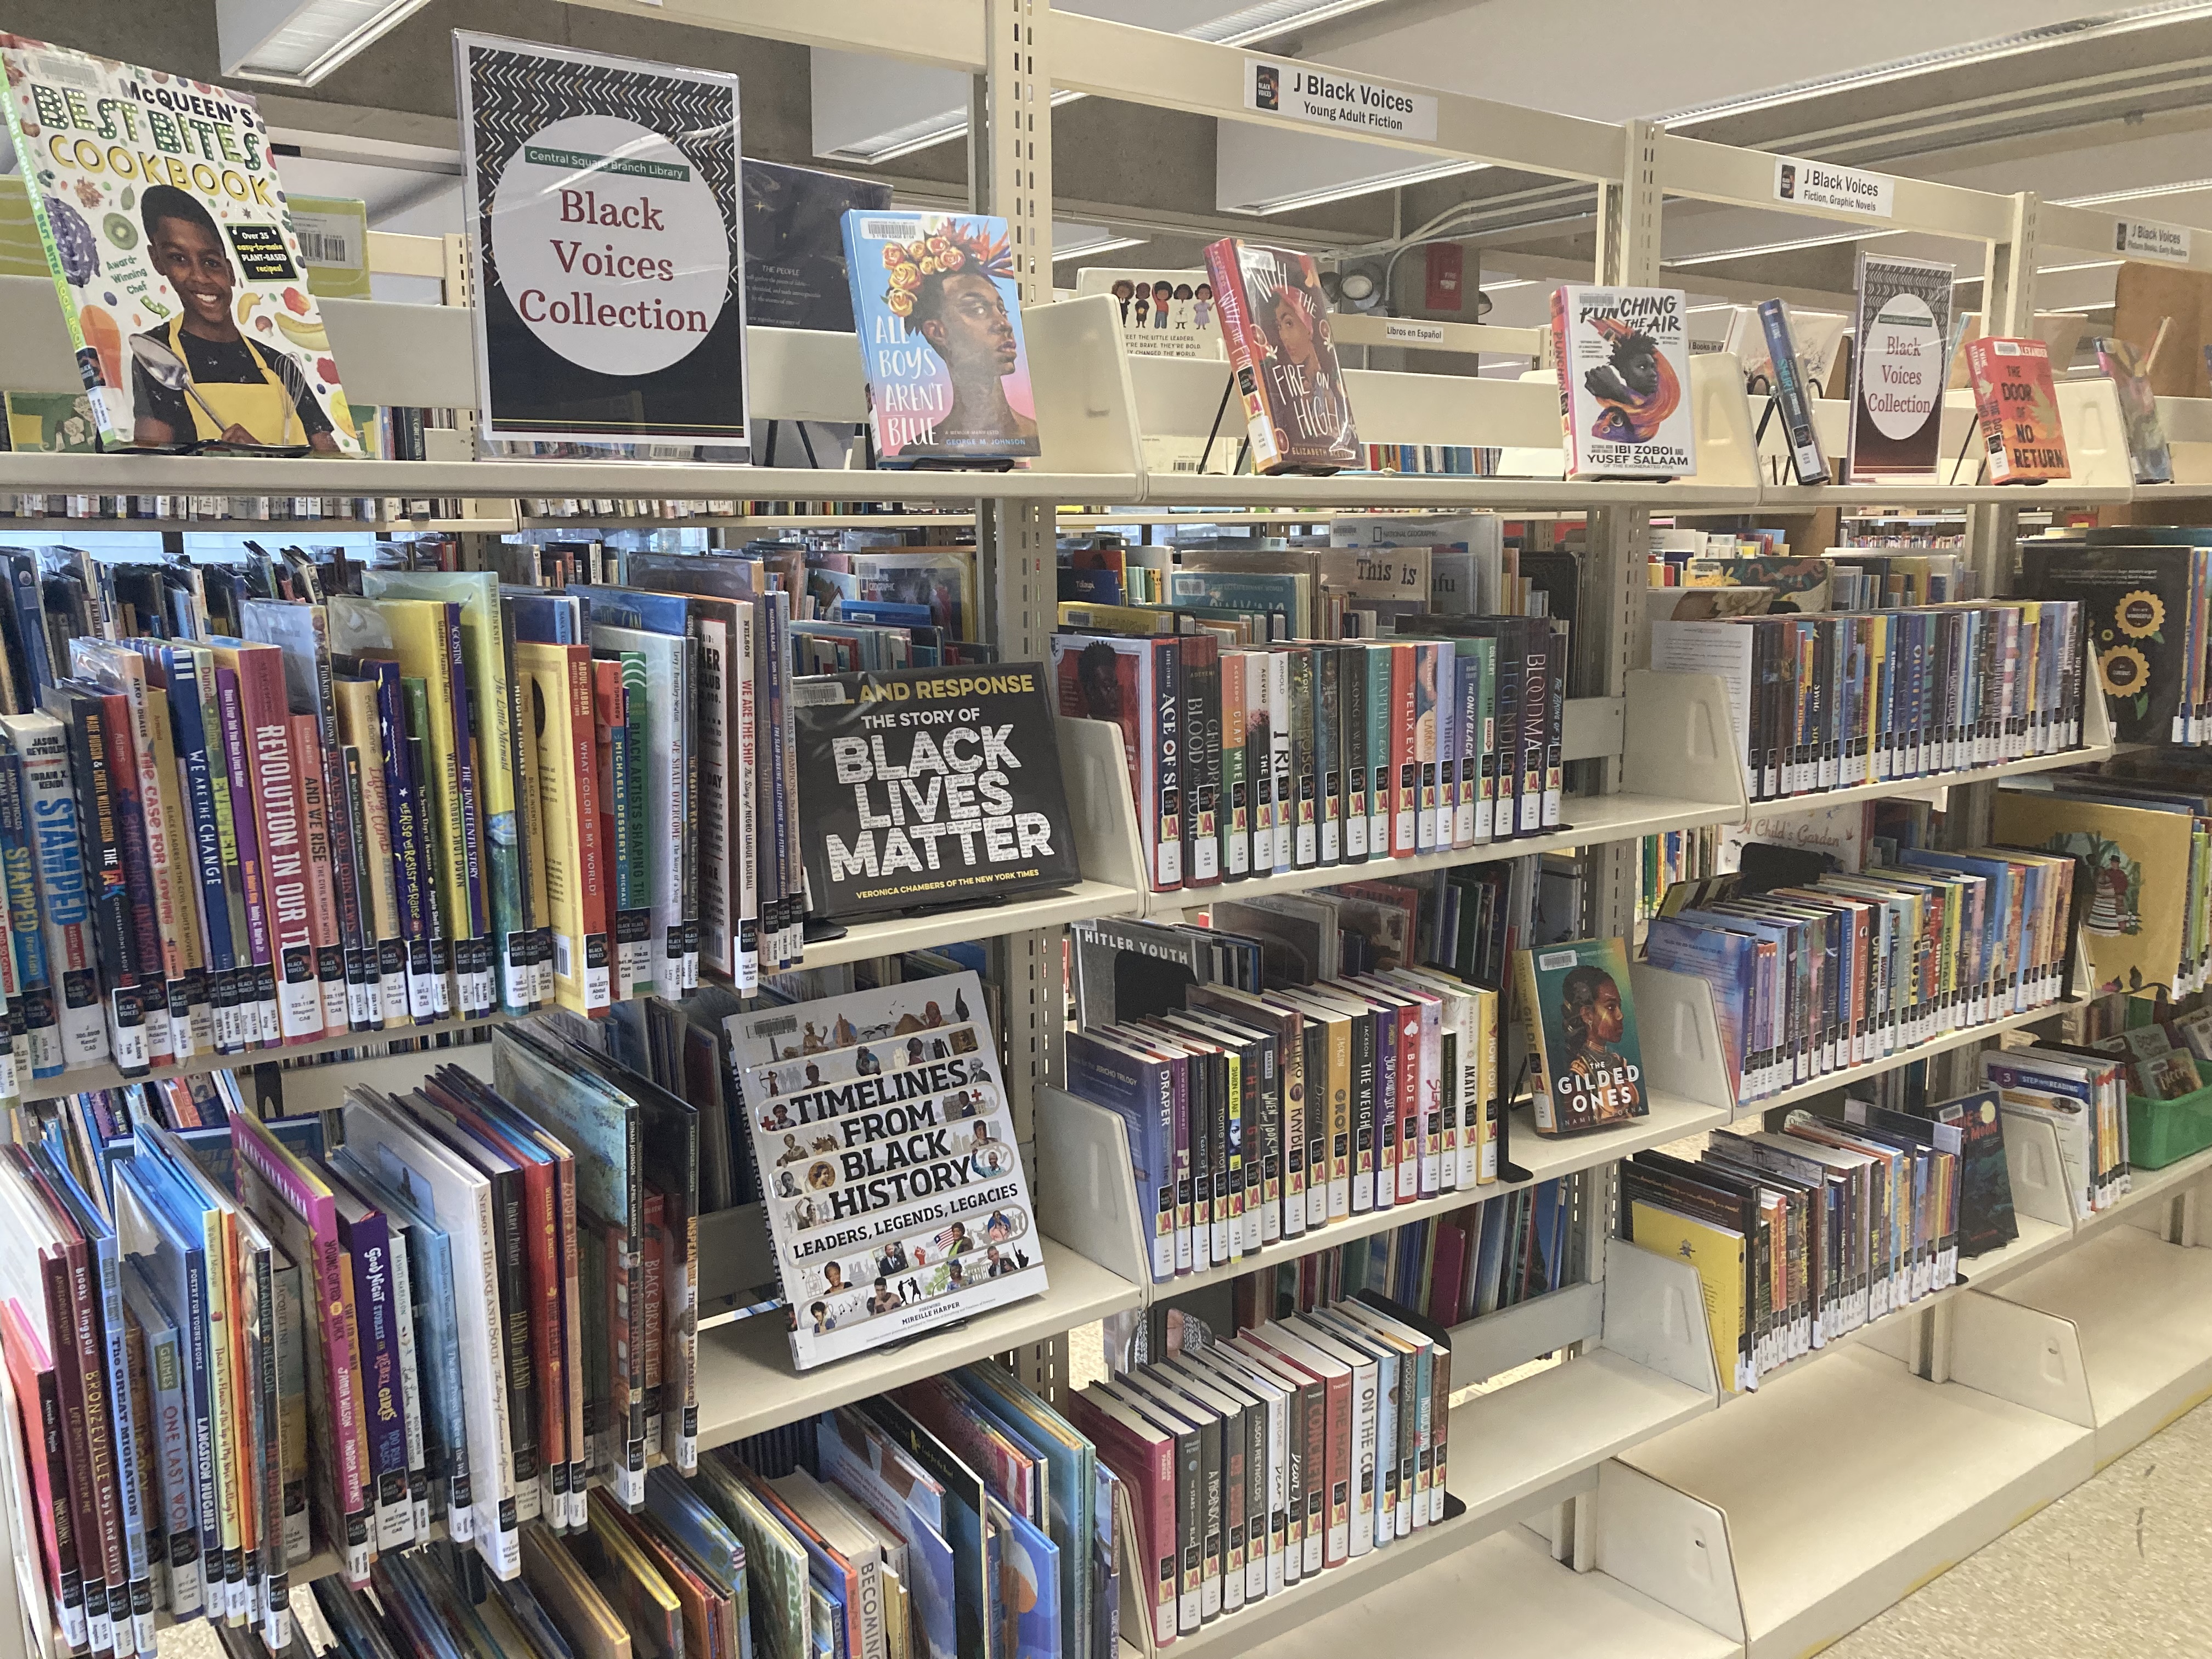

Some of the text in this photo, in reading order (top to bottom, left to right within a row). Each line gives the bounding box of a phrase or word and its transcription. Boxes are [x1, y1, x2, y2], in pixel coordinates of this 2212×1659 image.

[1257, 89, 1272, 98] VOICES
[1294, 72, 1413, 113] J Black Voices
[31, 83, 261, 171] BEST BITES
[1304, 101, 1403, 131] Young Adult Fiction
[48, 134, 275, 208] COOKBOOK
[529, 149, 684, 179] Central Square Branch Library
[1804, 169, 1878, 196] J Black Voices
[558, 188, 665, 232] Black
[1804, 190, 1876, 211] Fiction, Graphic Novels
[2137, 225, 2158, 241] Black
[2159, 229, 2181, 245] Voices
[110, 267, 148, 284] Winning
[550, 238, 674, 282] Voices
[126, 282, 148, 295] Chef
[1296, 290, 1317, 319] THE
[519, 289, 709, 334] Collection
[876, 315, 910, 345] ALL
[1625, 315, 1681, 333] THE AIR
[1387, 326, 1407, 336] Libros
[1417, 329, 1442, 339] Español
[1692, 342, 1710, 350] Books
[1886, 336, 1922, 357] Black
[879, 348, 936, 380] BOYS
[1317, 370, 1329, 391] ON
[1882, 364, 1922, 385] Voices
[2006, 365, 2022, 378] THE
[1272, 363, 1310, 406] FIRE
[1868, 392, 1932, 413] Collection
[2001, 382, 2033, 402] DOOR
[887, 416, 940, 447] BLUE
[1293, 396, 1342, 439] HIGH
[2015, 423, 2034, 444] NO
[1587, 454, 1689, 466] YUSEF SALAAM
[2013, 448, 2066, 469] RETURN
[1356, 558, 1392, 582] This
[1401, 563, 1417, 586] is
[451, 624, 462, 665] AGOSTINI
[743, 619, 751, 658] NELSON
[320, 664, 335, 744] Pinkney Brown
[578, 661, 590, 716] ABDUL-JABBAR
[859, 682, 911, 703] AND
[916, 674, 1035, 700] RESPONSE
[1352, 681, 1360, 719] SONG
[1467, 694, 1475, 718] ONLY
[860, 707, 980, 730] THE STORY OF
[1159, 692, 1176, 735] ACE
[1406, 692, 1414, 731] FELIX
[831, 723, 1023, 785] BLACK
[1162, 742, 1177, 769] OF
[1465, 720, 1475, 757] BLACK
[1260, 754, 1269, 775] THE
[189, 749, 222, 886] WE ARE THE CHANGE
[580, 741, 597, 897] WHAT COLOR IS MY WORLD?
[615, 741, 627, 862] MICHAELS DESSERTS
[630, 722, 645, 908] BLACK ARTISTS SHAPING THE
[854, 770, 1014, 830] LIVES
[256, 724, 308, 923] REVOLUTION IN OUR
[304, 777, 327, 863] AND WE RISE
[462, 765, 478, 878] THE JUNETEENTH STORY
[1737, 818, 1839, 848] A Child's Garden
[33, 798, 88, 926] STAMPED
[825, 811, 1056, 882] MATTER
[5, 846, 39, 933] STAMPED
[855, 868, 1040, 900] VERONICA CHAMBERS OF THE NEW YORK TIMES
[1085, 928, 1188, 966] HITLER YOUTH
[789, 1058, 970, 1126] TIMELINES
[1464, 1065, 1476, 1099] AKATA
[1558, 1064, 1640, 1096] GILDED
[2004, 1073, 2011, 1082] 3
[1160, 1069, 1171, 1127] DRAPER
[1572, 1086, 1632, 1114] ONES
[840, 1099, 938, 1148] FROM
[840, 1128, 952, 1182] BLACK
[828, 1155, 972, 1221] HISTORY
[792, 1182, 1019, 1260] LEADERS, LEGENDS, LEGACIES
[75, 1266, 96, 1356] Brooks Ringgold
[259, 1261, 275, 1394] ALEXANDER NELSON
[162, 1346, 175, 1391] GRIMES
[111, 1338, 139, 1517] The GREAT MIGRATION
[1361, 1388, 1375, 1447] ON THE
[163, 1405, 185, 1483] ONE LAST
[196, 1417, 215, 1533] LANGSTON HUGHES
